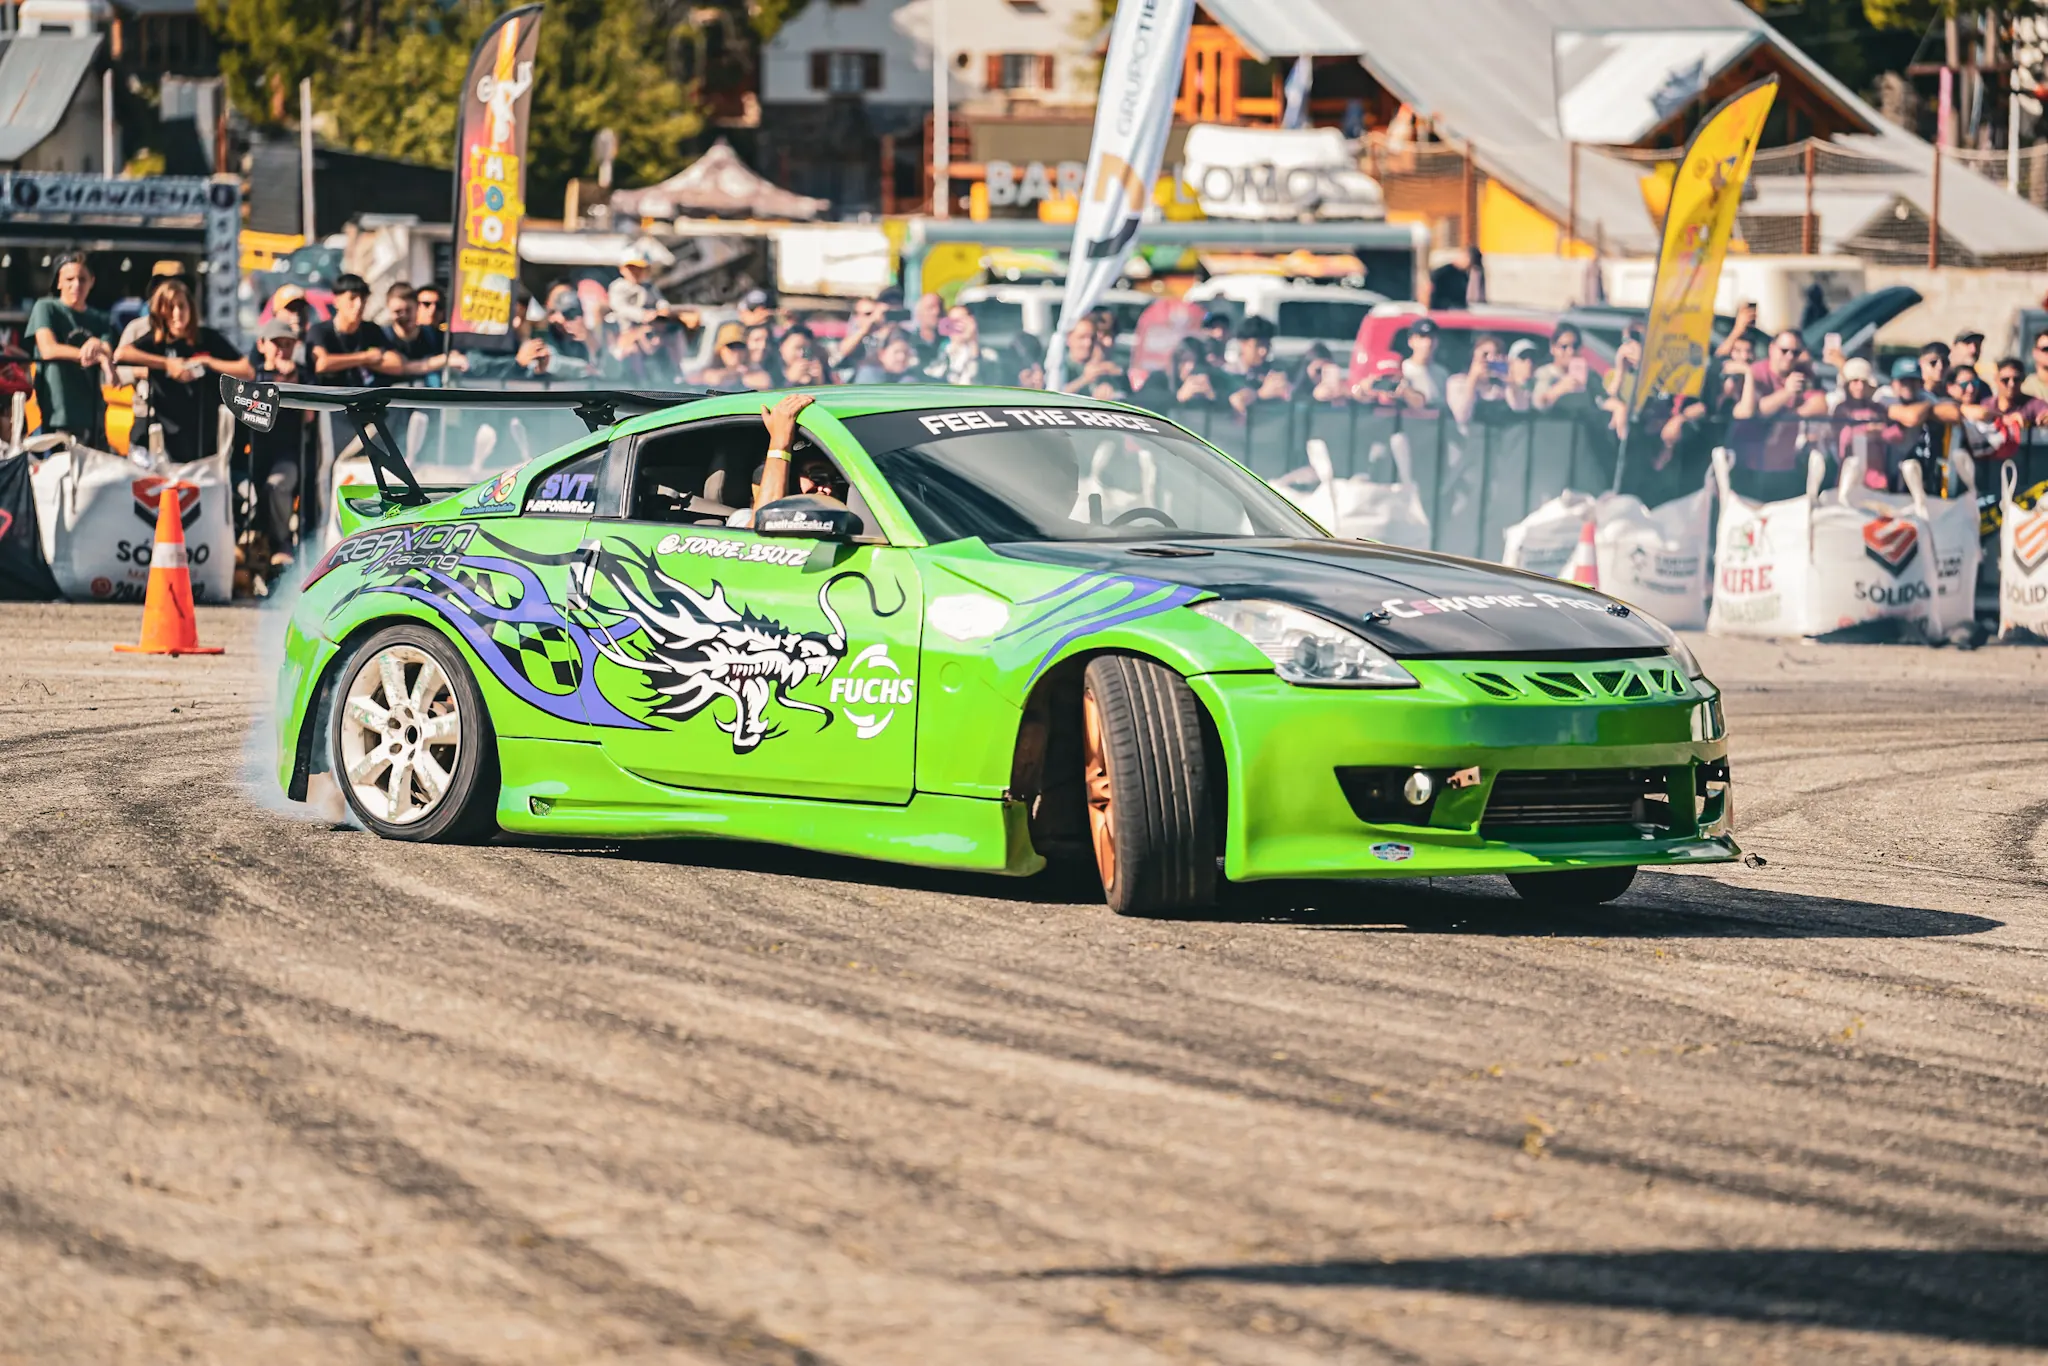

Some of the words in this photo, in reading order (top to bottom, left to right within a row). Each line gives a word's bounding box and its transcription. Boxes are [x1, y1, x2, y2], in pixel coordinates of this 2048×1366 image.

[233, 395, 272, 412] REAXION
[918, 411, 1009, 435] FEEL
[1002, 409, 1077, 426] THE
[1073, 410, 1160, 433] RACE
[542, 474, 595, 502] SVT
[328, 522, 480, 573] REAXION
[384, 549, 461, 572] Racing
[1381, 594, 1538, 618] CERAMIC
[829, 678, 915, 705] FUCHS
